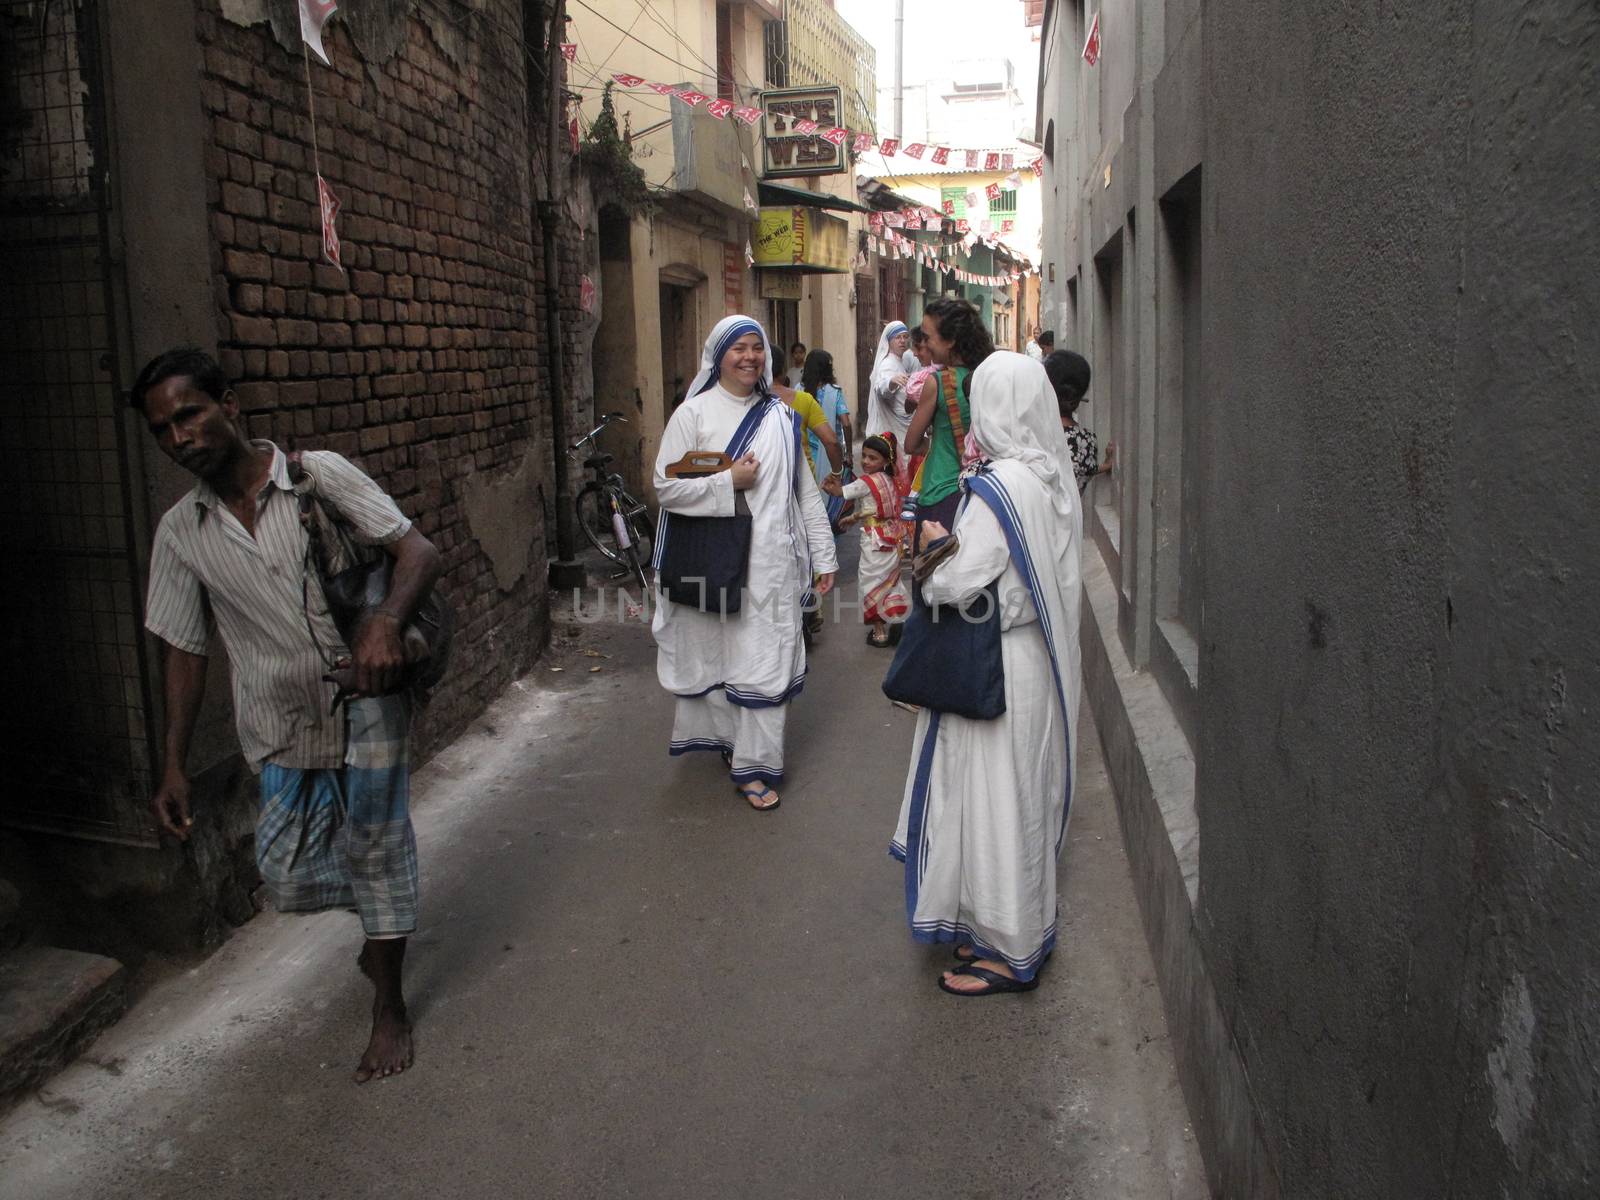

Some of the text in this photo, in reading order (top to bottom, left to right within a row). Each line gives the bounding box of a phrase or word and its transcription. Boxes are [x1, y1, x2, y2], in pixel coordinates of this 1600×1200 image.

[767, 98, 836, 131] THE
[767, 133, 837, 165] WEB
[758, 224, 789, 246] THE WEB
